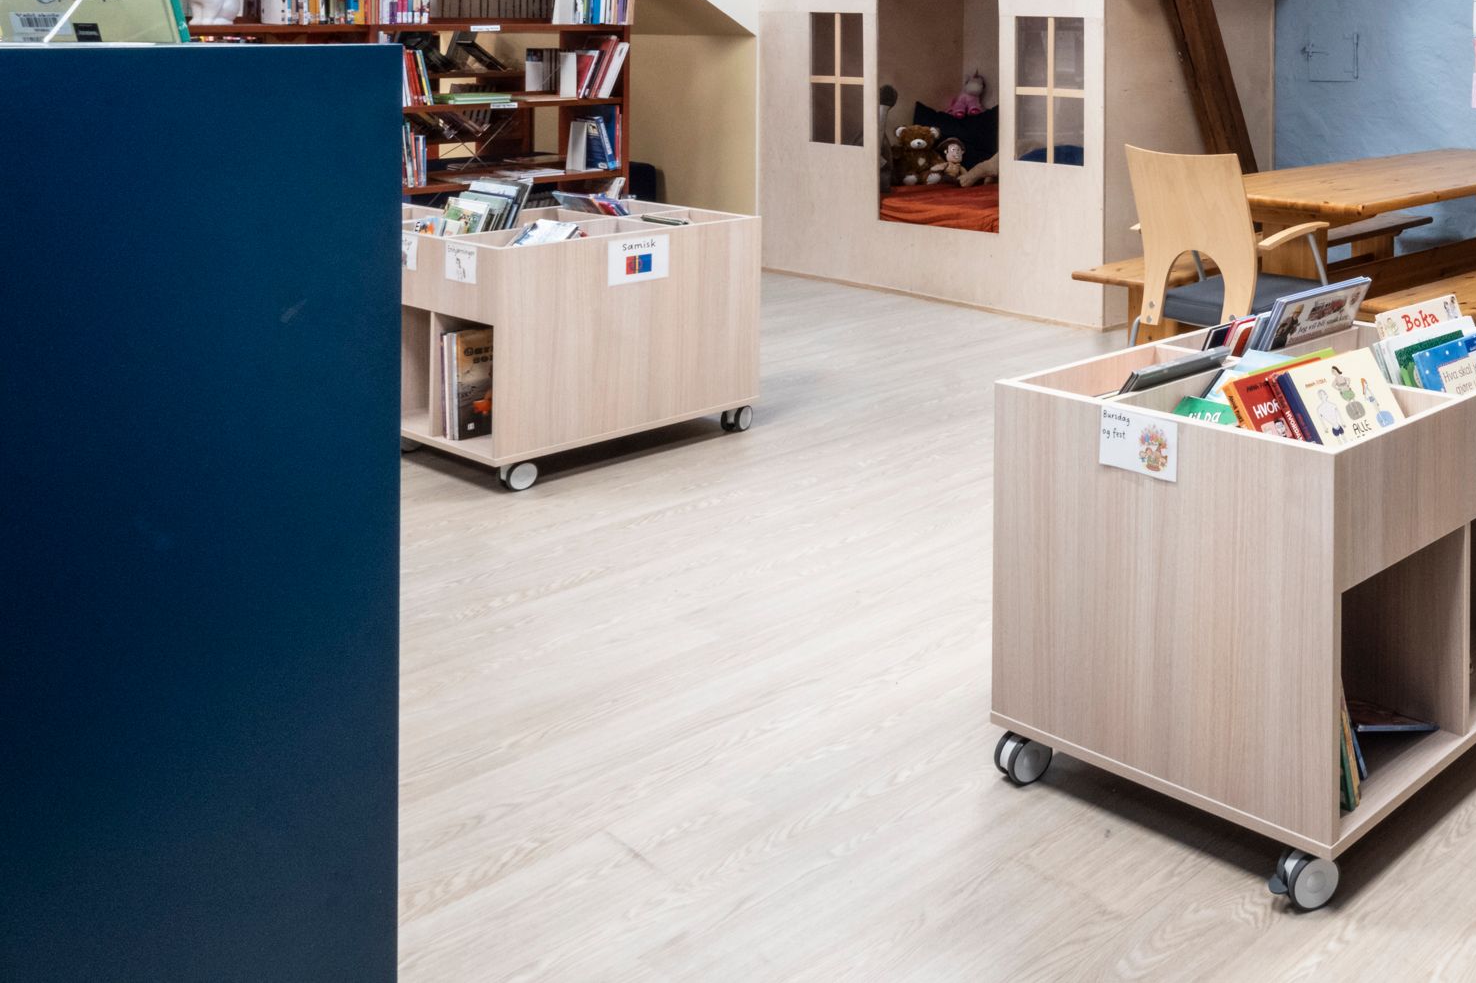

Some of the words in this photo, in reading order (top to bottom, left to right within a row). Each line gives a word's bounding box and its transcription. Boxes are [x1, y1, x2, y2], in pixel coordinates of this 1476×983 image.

[1401, 309, 1439, 332] Boka
[1442, 368, 1458, 383] Hva
[1458, 364, 1473, 379] skal
[1103, 409, 1130, 426] Bursdag
[1102, 429, 1110, 438] og
[1112, 428, 1126, 439] fest
[1352, 419, 1372, 435] ALLE
